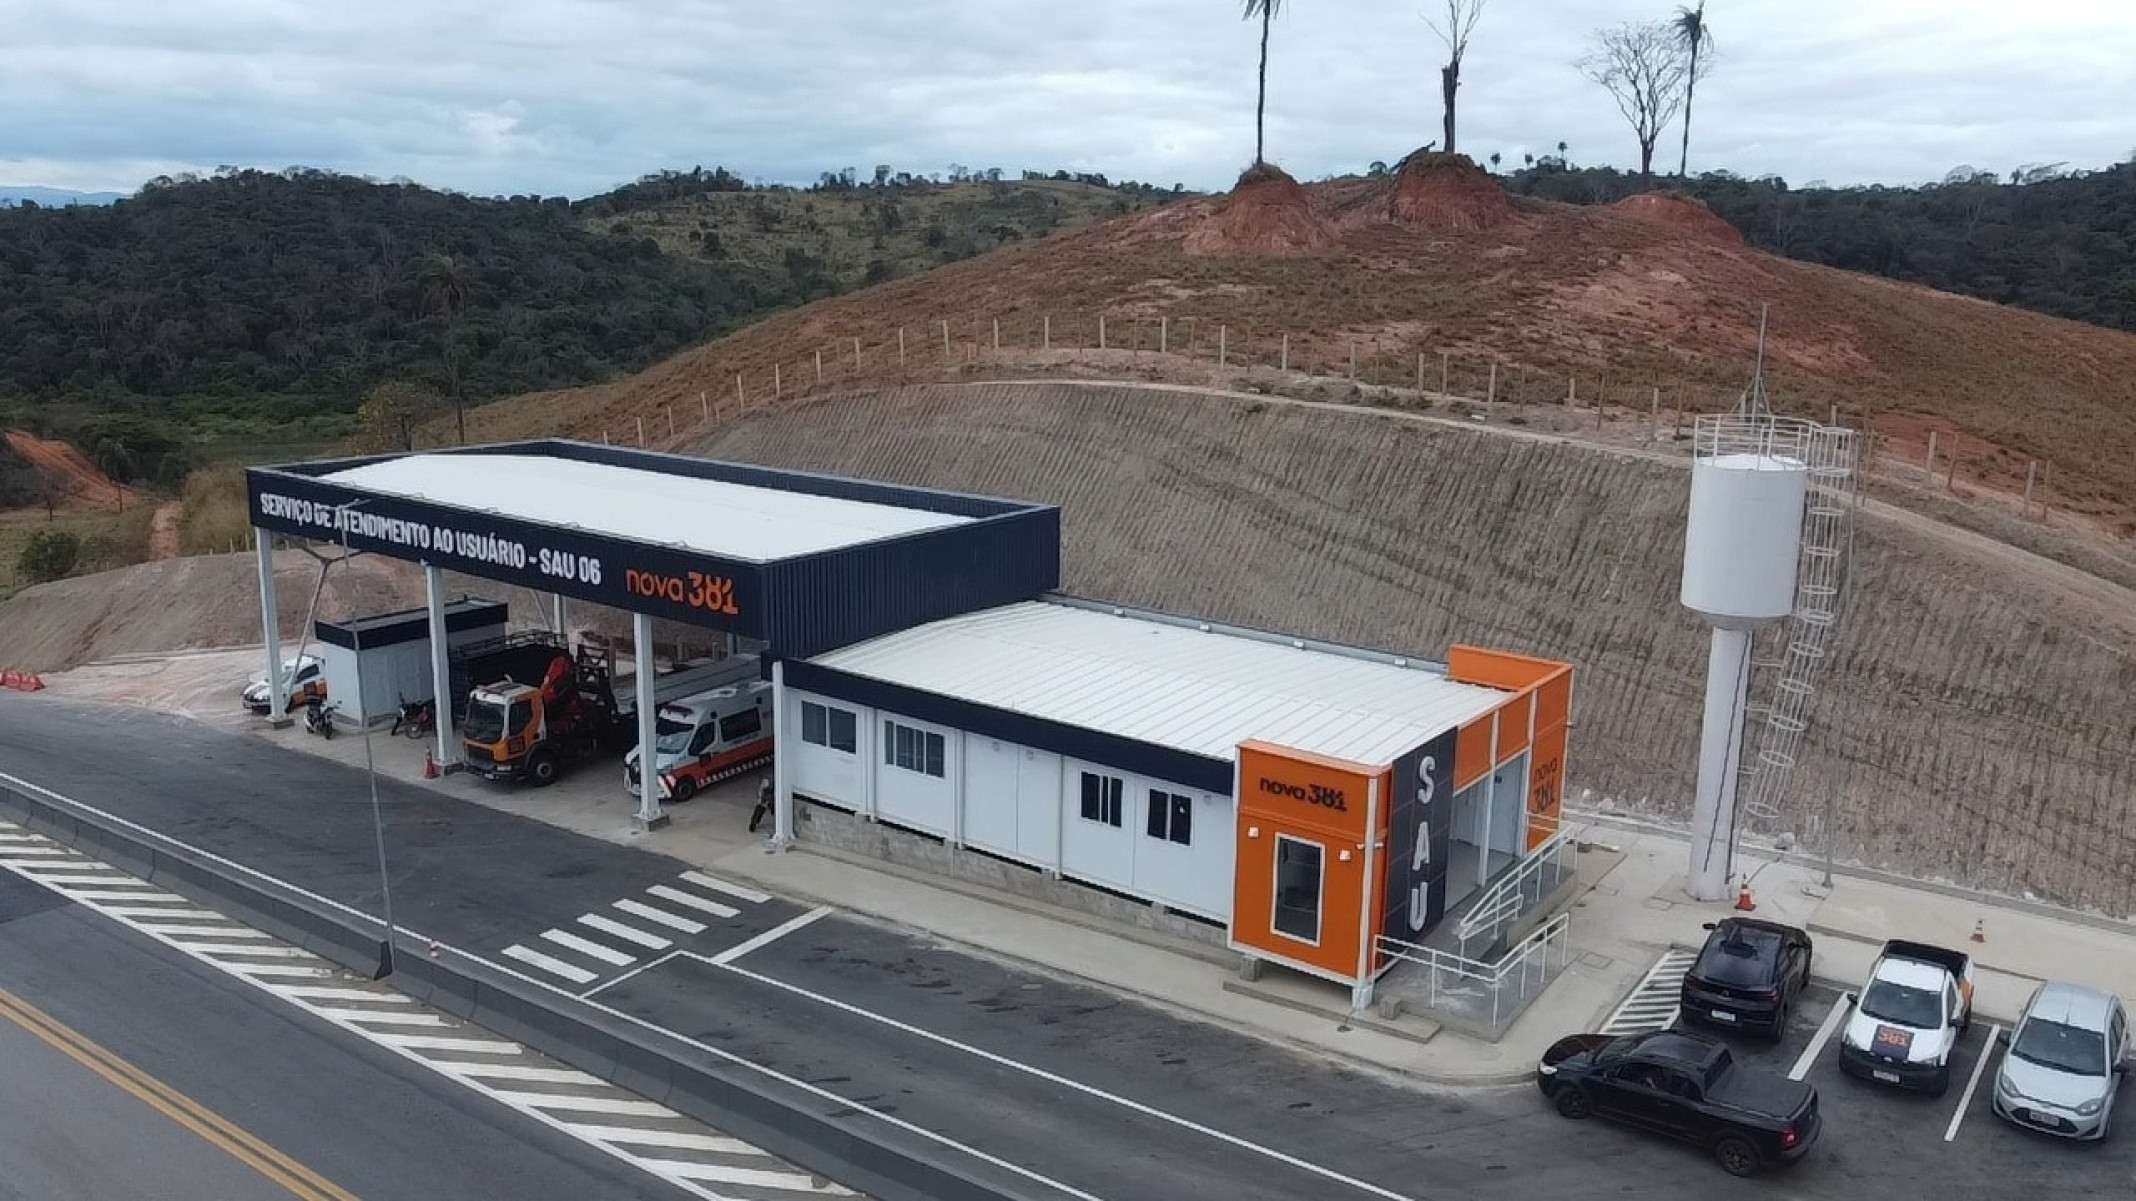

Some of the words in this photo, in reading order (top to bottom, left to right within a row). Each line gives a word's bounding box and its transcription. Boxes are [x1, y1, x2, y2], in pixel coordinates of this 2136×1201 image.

[260, 492, 313, 526] SERVIÇO
[314, 503, 333, 528] DE
[333, 504, 430, 550] ATENDIMENTO
[433, 526, 453, 554] AO
[456, 532, 525, 569] USUÁRIO
[528, 556, 538, 564] -
[539, 548, 575, 580] SAU
[578, 556, 601, 585] 06
[626, 569, 684, 602] nova
[688, 571, 739, 615] 381
[1260, 777, 1306, 801] nova
[1308, 784, 1347, 812] 381
[1409, 755, 1436, 932] SAU
